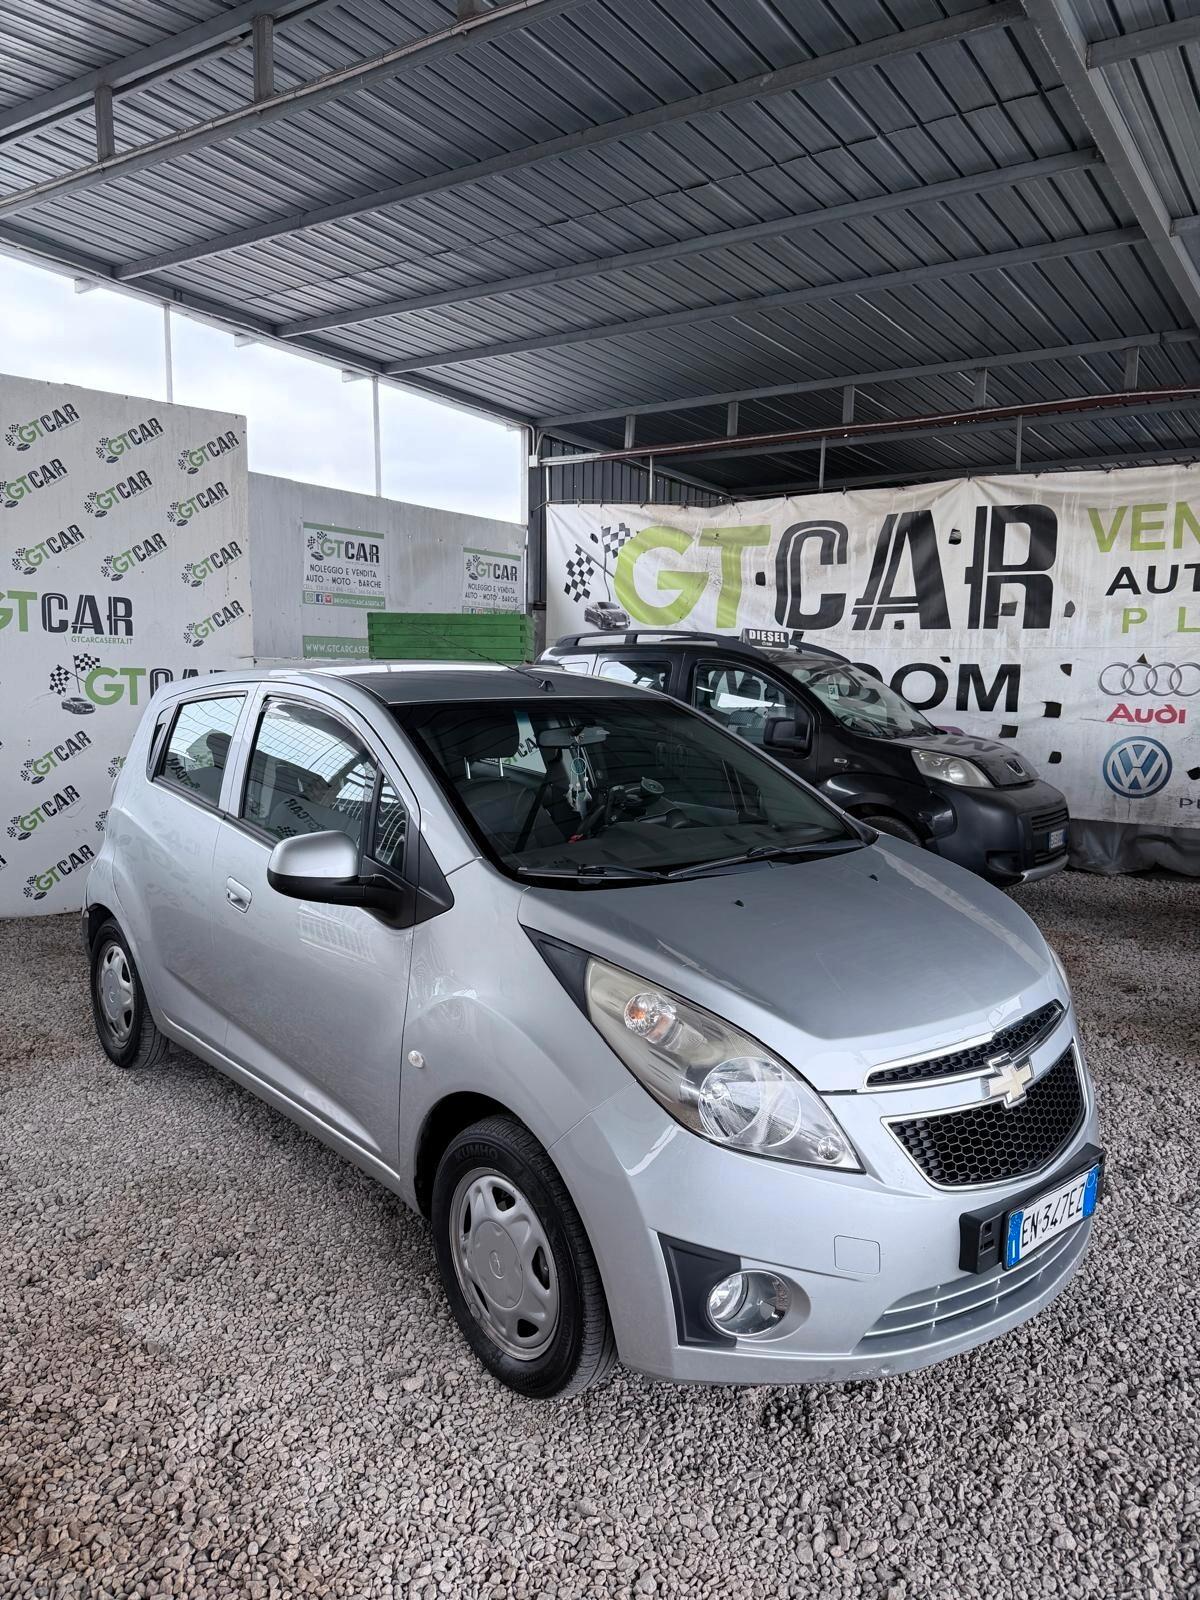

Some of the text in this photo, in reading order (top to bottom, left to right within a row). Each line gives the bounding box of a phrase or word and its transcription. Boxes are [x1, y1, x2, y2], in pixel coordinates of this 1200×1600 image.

[309, 564, 344, 575] NOLEGGIO
[345, 568, 350, 576] E
[351, 568, 377, 578] VENDITA
[306, 574, 324, 583] AUTO
[331, 576, 351, 586] MOTO
[358, 579, 382, 589] BARCHE
[748, 629, 786, 643] DIESEL
[1106, 703, 1186, 724] Audi
[1179, 796, 1200, 808] P
